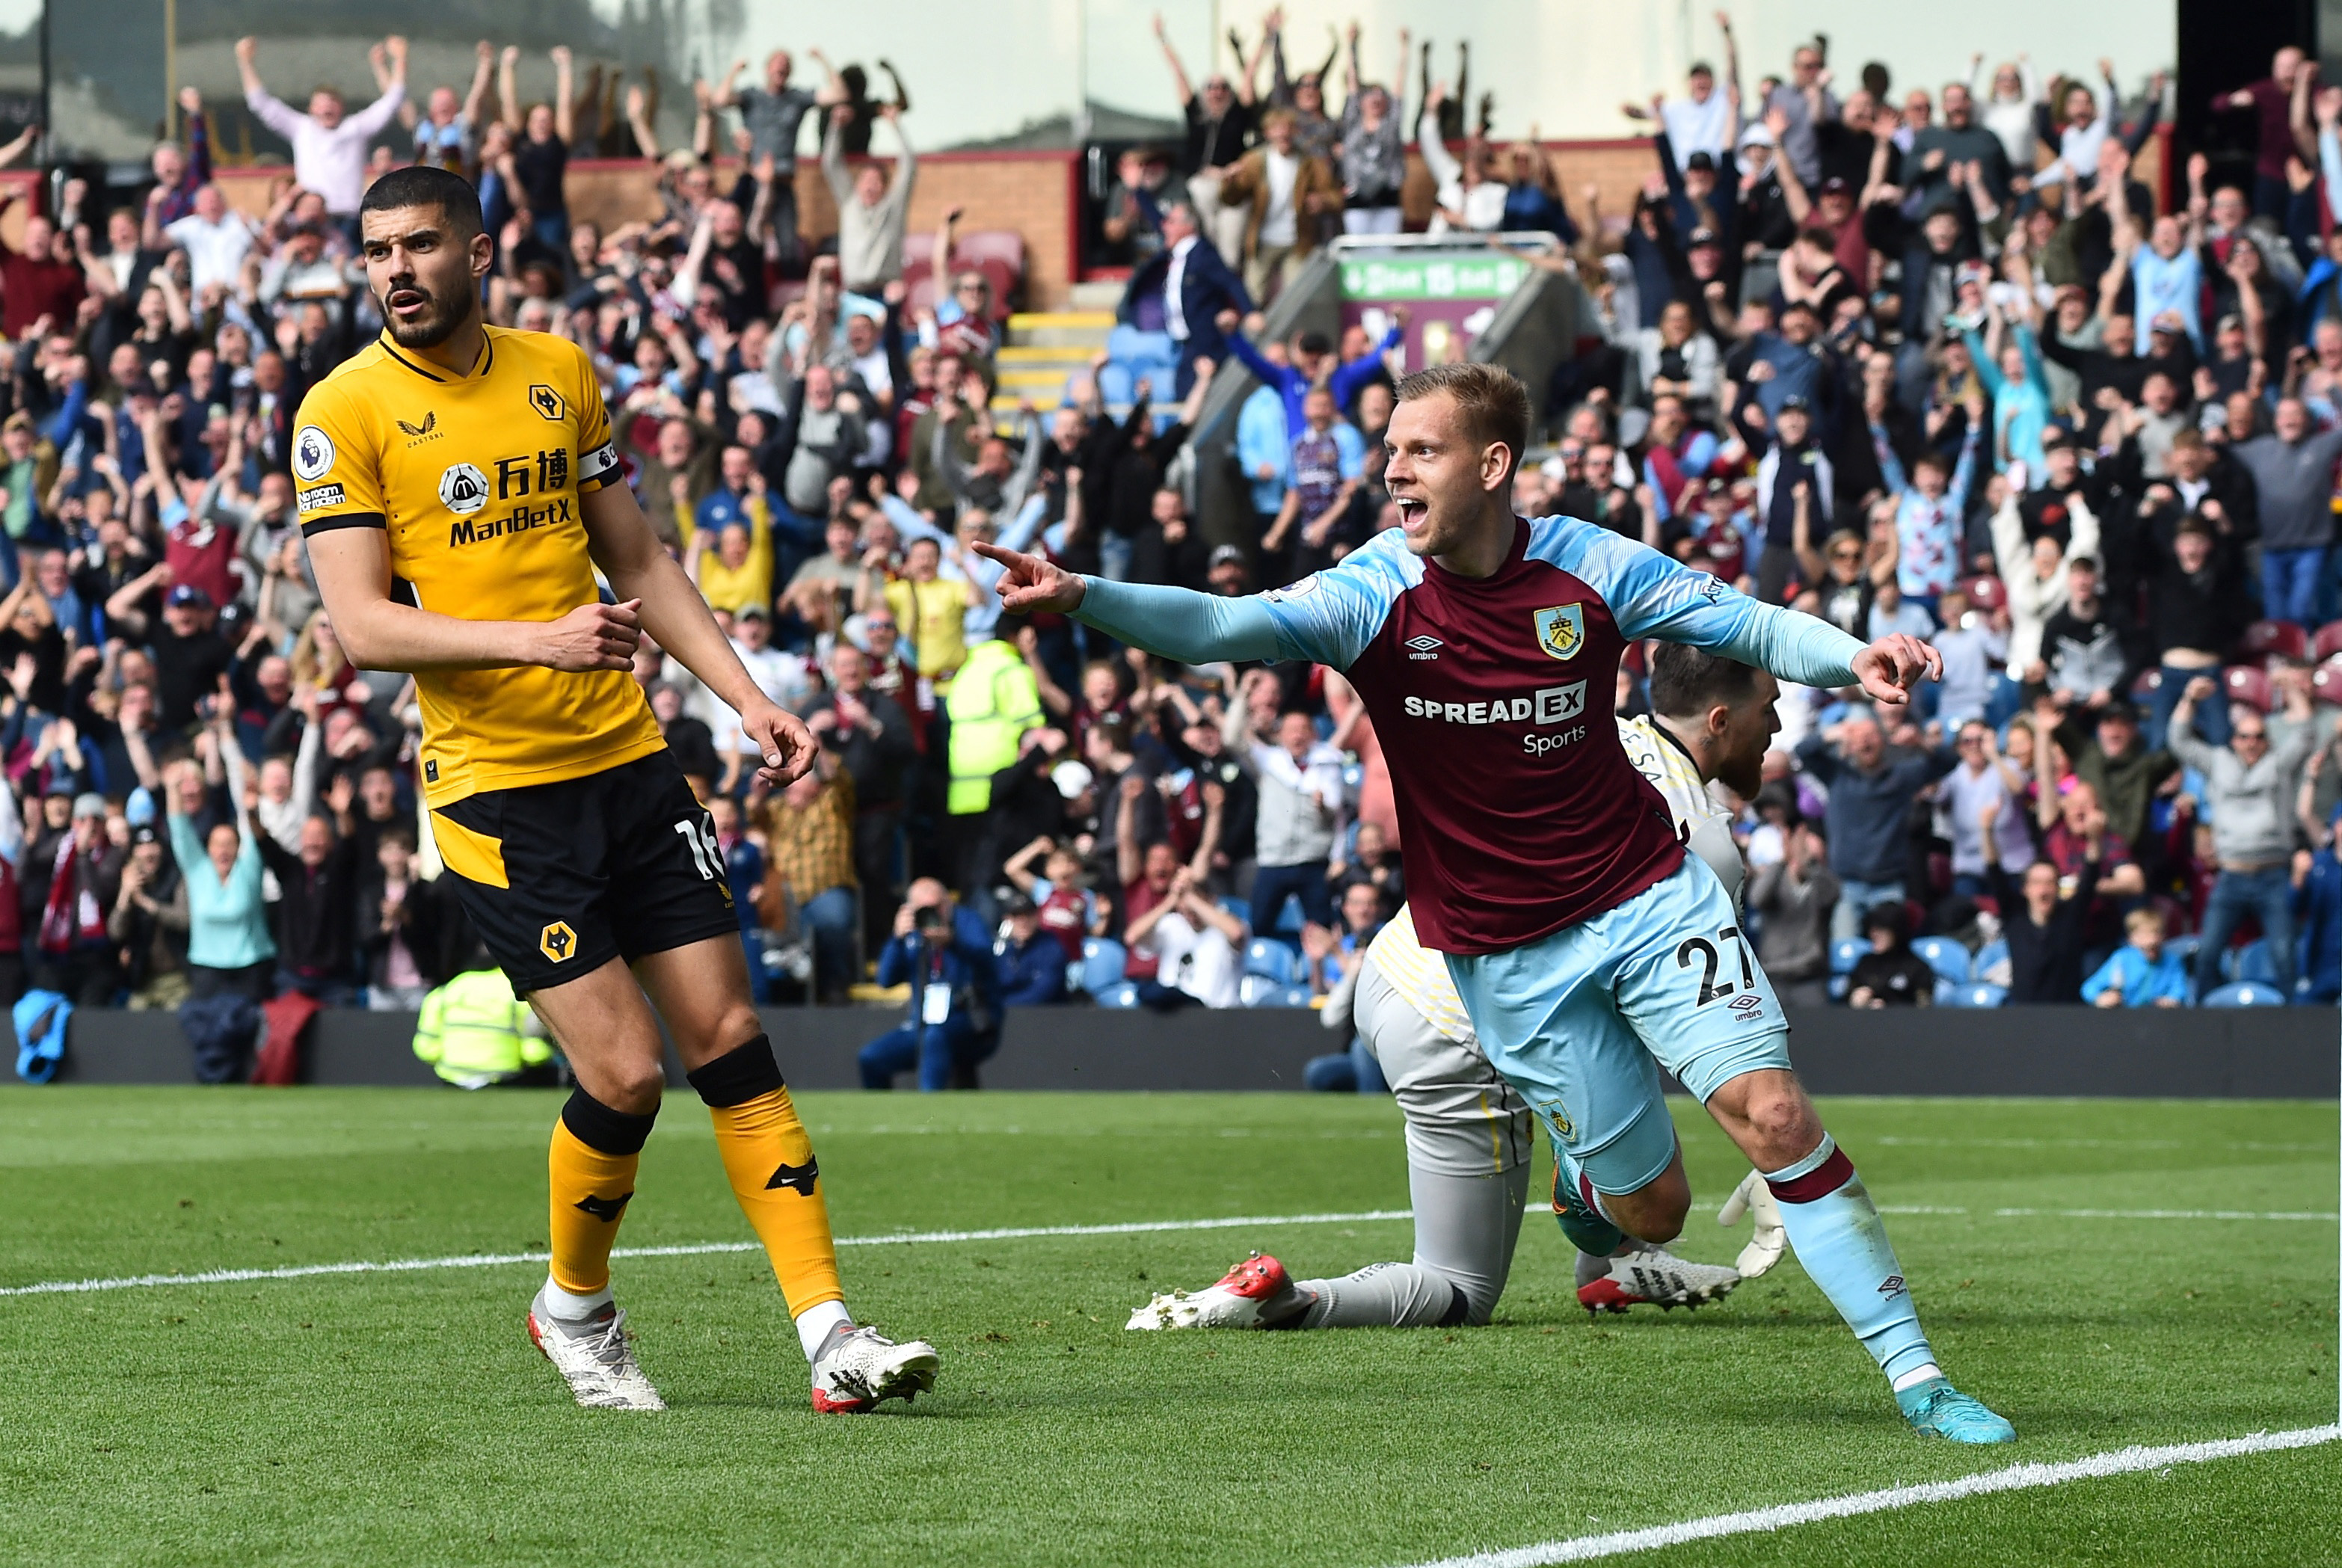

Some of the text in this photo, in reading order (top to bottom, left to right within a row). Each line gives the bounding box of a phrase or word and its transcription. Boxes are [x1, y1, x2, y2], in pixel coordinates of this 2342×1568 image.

[407, 431, 444, 449] CASTORE
[494, 448, 568, 500] 万博
[298, 486, 339, 502] No room
[312, 494, 346, 509] racism
[449, 498, 571, 548] ManBetX
[1409, 652, 1438, 660] umbro
[1523, 725, 1586, 757] Sports
[1676, 926, 1755, 1008] 27
[1735, 1009, 1762, 1021] umbro
